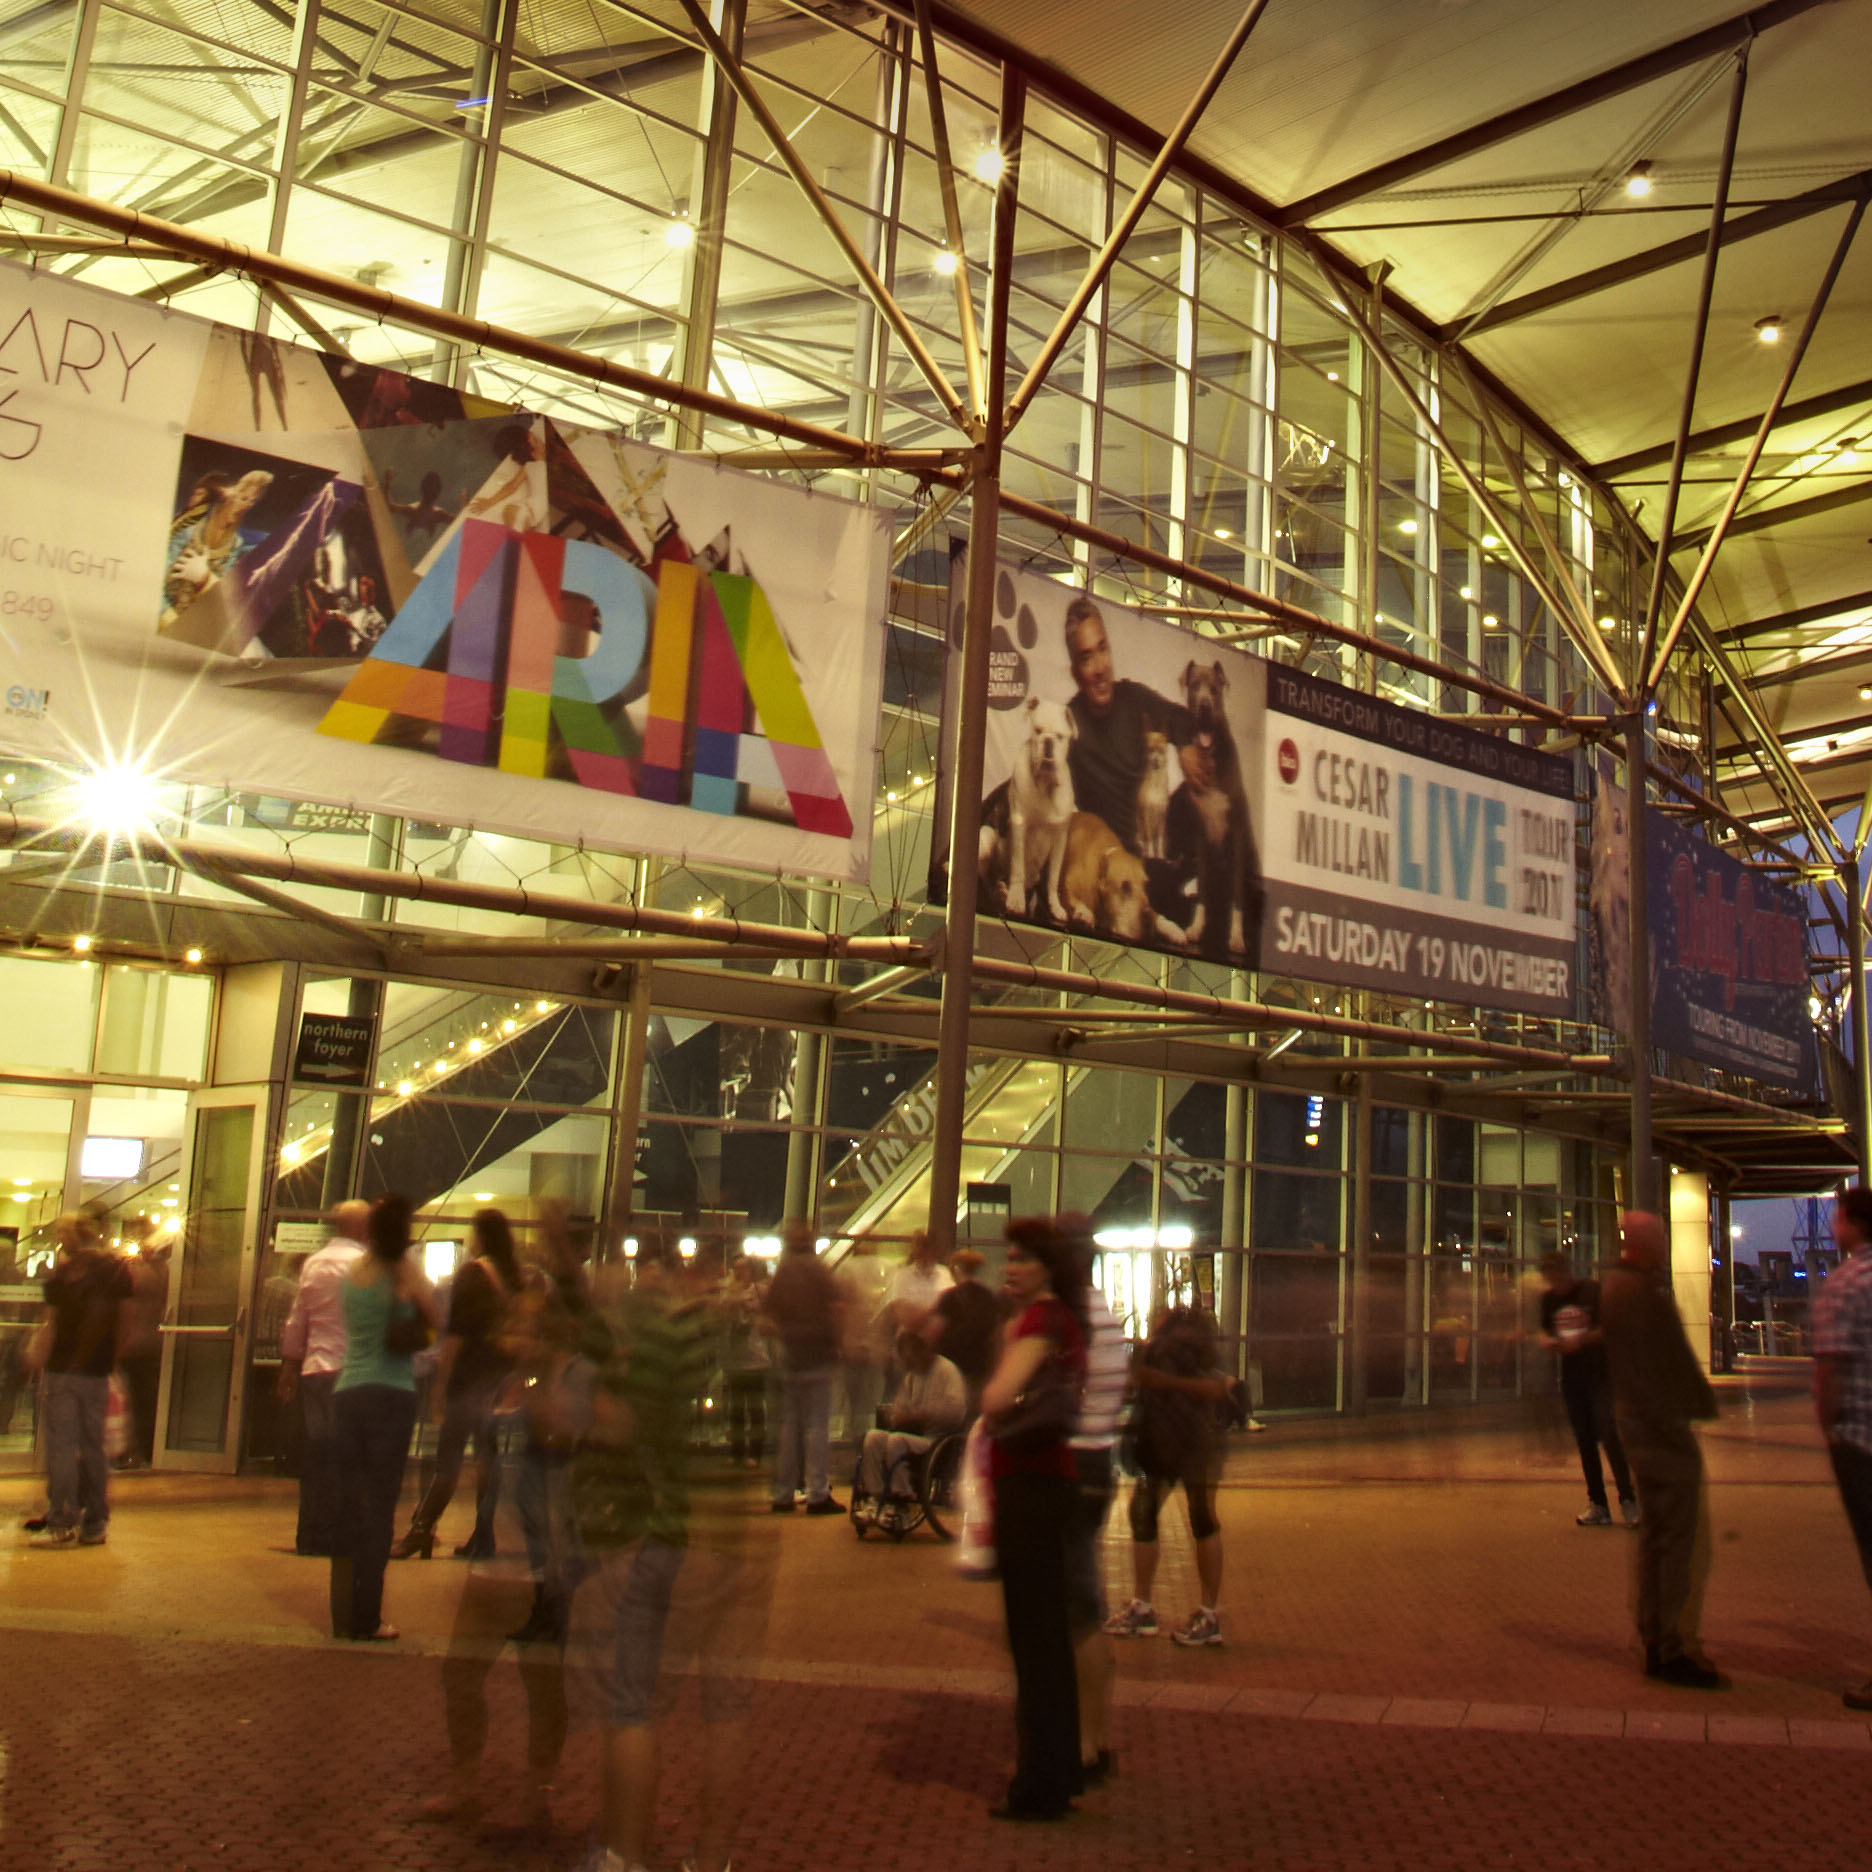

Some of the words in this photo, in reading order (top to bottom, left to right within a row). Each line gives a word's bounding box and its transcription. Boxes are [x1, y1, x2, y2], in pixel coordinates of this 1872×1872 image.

[37, 542, 125, 582] NIGHT
[0, 589, 55, 623] 849
[315, 516, 854, 840] ARIA
[989, 651, 1017, 666] RAND
[988, 682, 1025, 697] EMINAR
[1278, 678, 1378, 731] TRANSFORM
[1383, 714, 1428, 746] YOUR
[1430, 729, 1466, 762] DOG
[1469, 742, 1501, 771] AND
[1312, 749, 1390, 820] CESAR
[1295, 809, 1390, 885] MILLAN
[1398, 773, 1507, 911] LIVE
[1276, 905, 1414, 973] SATURDAY
[1415, 935, 1445, 979] 19
[1450, 940, 1569, 999] NOVEMBER
[303, 1021, 368, 1041] northern
[314, 1038, 354, 1059] foyer
